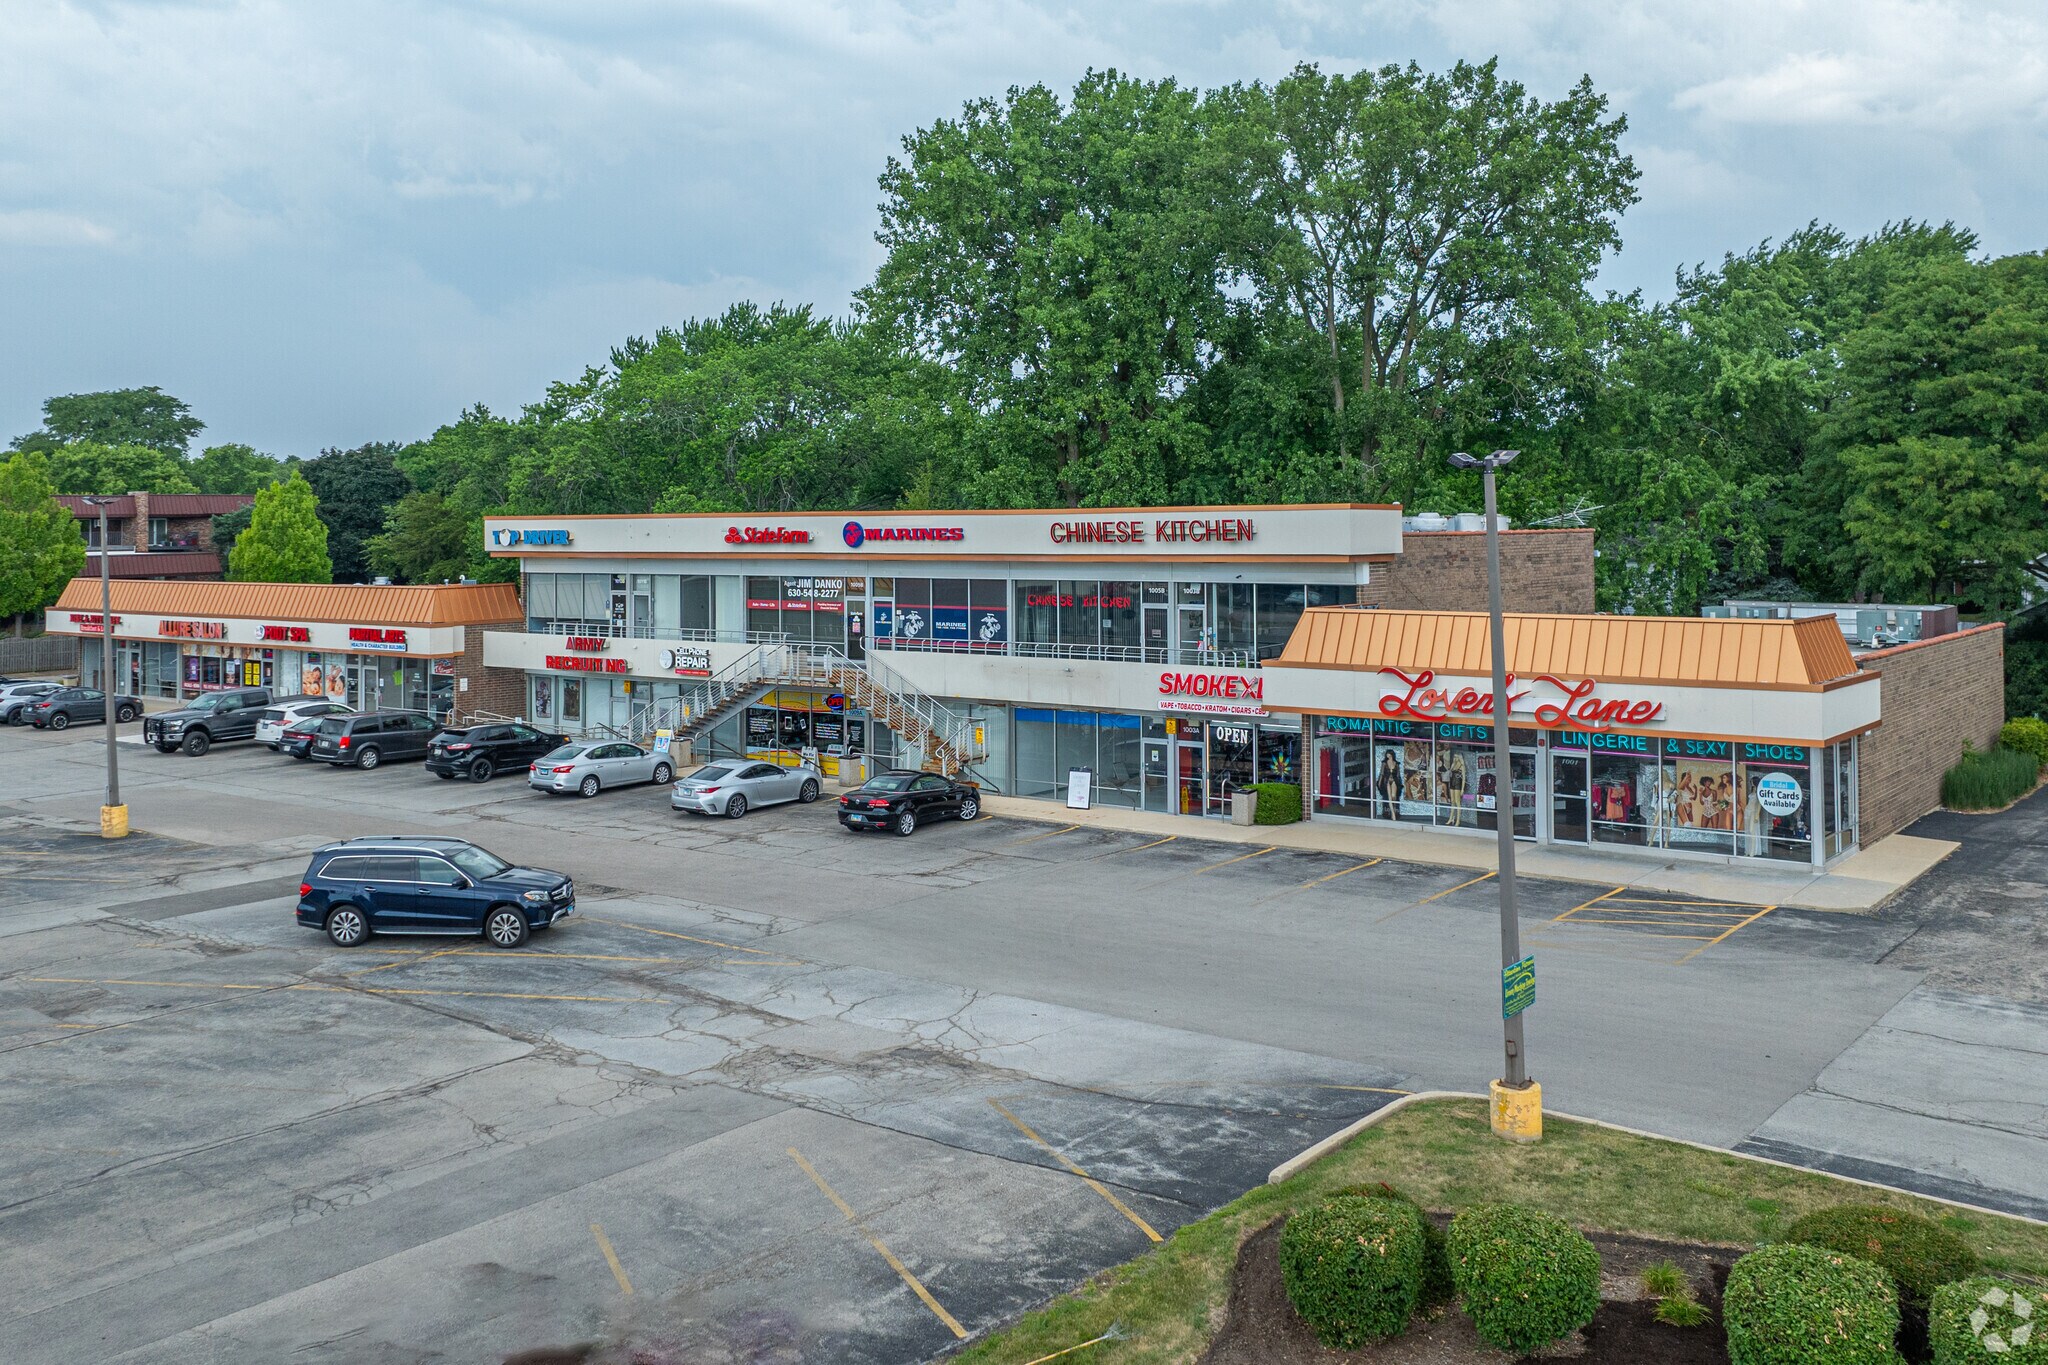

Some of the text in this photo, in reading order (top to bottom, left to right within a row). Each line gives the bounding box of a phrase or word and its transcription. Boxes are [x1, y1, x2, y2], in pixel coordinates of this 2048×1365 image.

[523, 529, 572, 545] DRIVER
[864, 527, 965, 542] MARINES
[1050, 518, 1254, 543] CHINESE KITCHEN
[797, 579, 811, 589] JIM
[815, 579, 843, 589] DANKO
[1027, 594, 1074, 607] CHINESE
[158, 620, 224, 639] ALLURE SALON
[290, 626, 309, 642] SPA
[384, 629, 406, 643] ARTS
[565, 636, 605, 651] ARMY
[675, 656, 709, 669] REPAIR
[1177, 703, 1202, 711] TOBACCO
[1205, 704, 1228, 712] KRATOM
[1231, 706, 1252, 714] CIGARS
[1532, 674, 1663, 733] Lane
[1183, 726, 1200, 734] 1003A
[1216, 726, 1249, 744] OPEN
[1327, 717, 1488, 740] ROMANTIC GIFTS
[1562, 730, 1805, 761] LINGERIE & SEXY SHOES
[1769, 781, 1788, 789] Bridal
[1759, 789, 1800, 801] Gift Cards
[1764, 799, 1796, 809] Available
